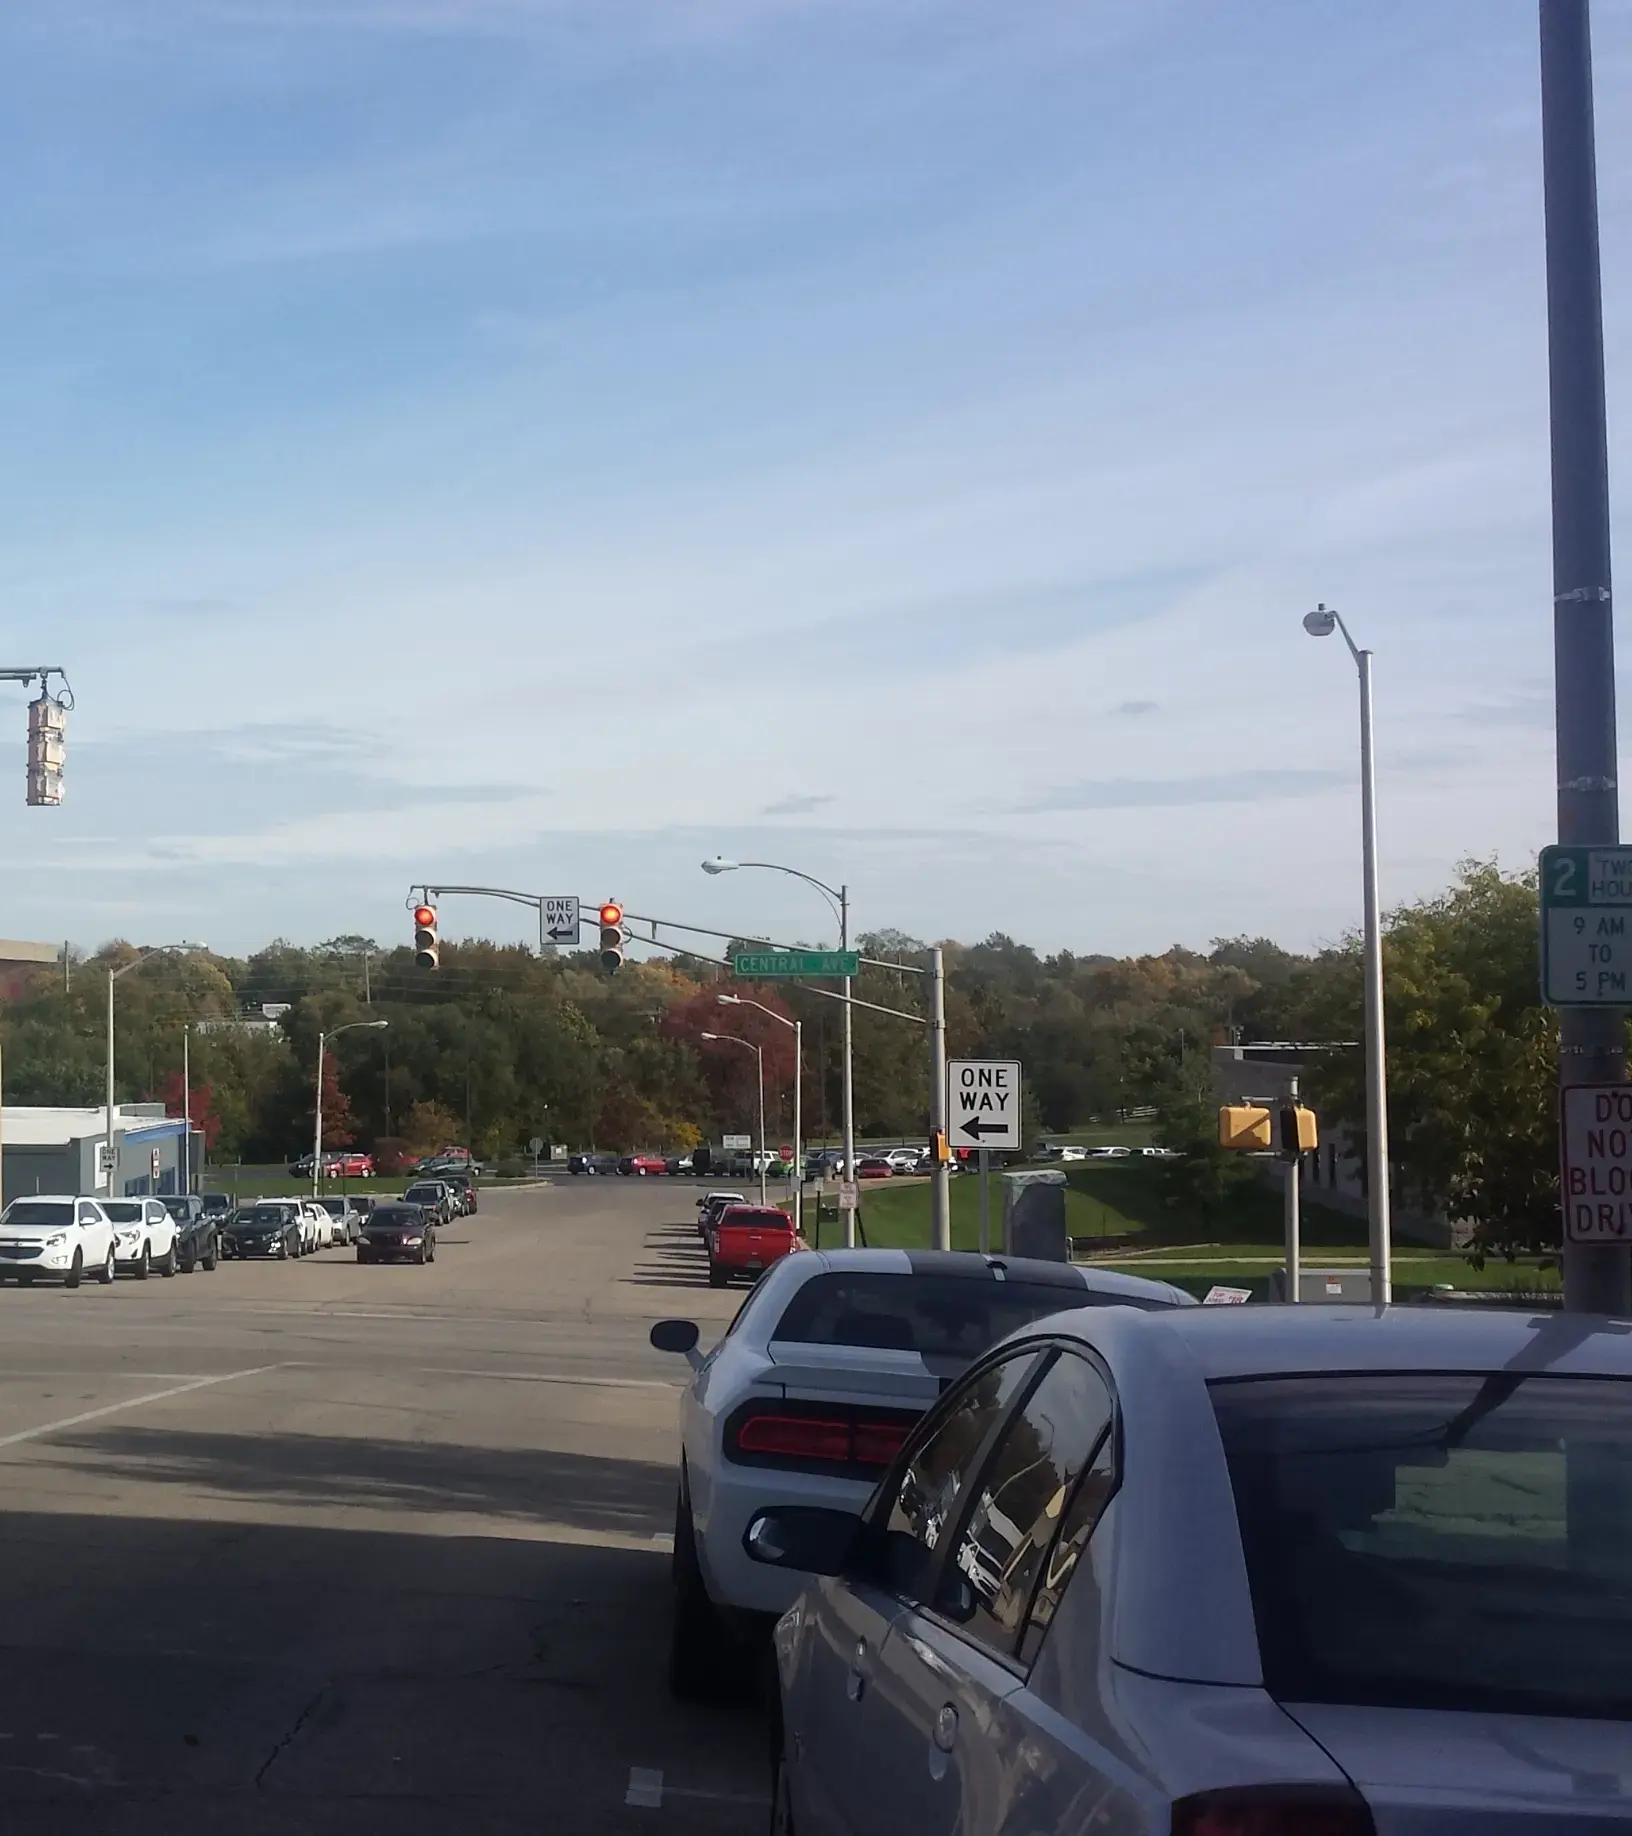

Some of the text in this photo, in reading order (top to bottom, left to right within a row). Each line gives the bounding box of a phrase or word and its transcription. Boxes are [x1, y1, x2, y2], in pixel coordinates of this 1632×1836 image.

[1553, 857, 1577, 897] 2
[546, 900, 573, 912] ONE
[546, 914, 574, 925] WAY
[1574, 916, 1624, 936] 9 AM
[1589, 944, 1612, 963] TO
[740, 957, 849, 972] CENTRAL AVE
[1575, 971, 1626, 992] 5 PM
[960, 1068, 1008, 1088] ONE
[959, 1092, 1010, 1112] WAY
[1596, 1094, 1632, 1123] DO
[779, 1149, 794, 1157] STOP
[1588, 1129, 1632, 1158] NO
[1570, 1166, 1632, 1195] BLO
[1576, 1203, 1632, 1233] DRI
